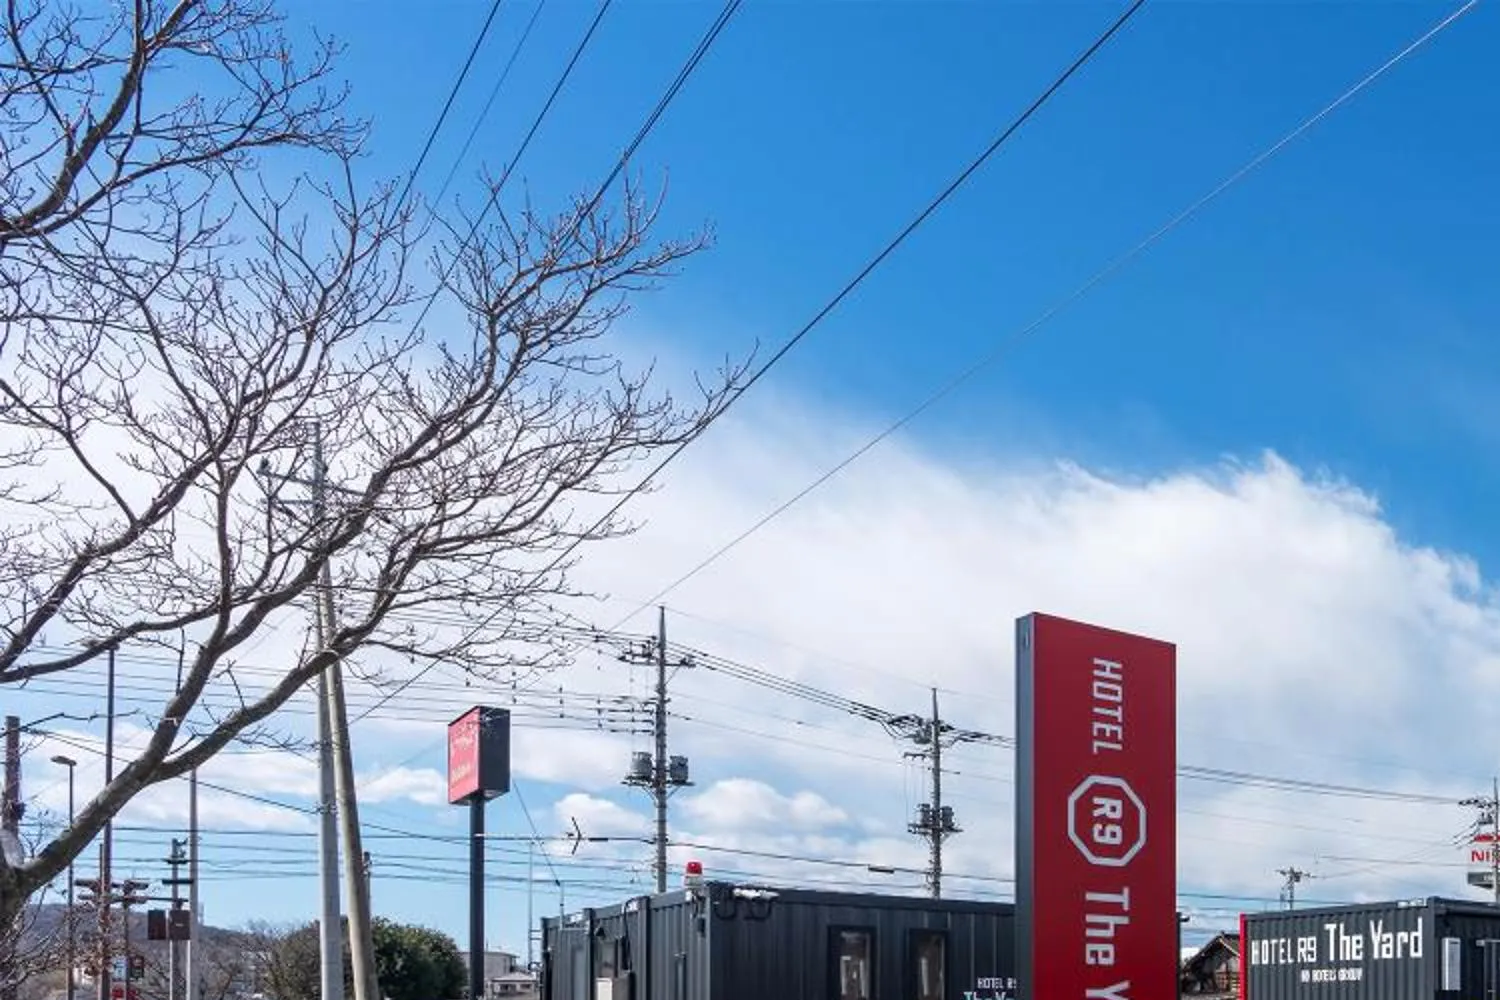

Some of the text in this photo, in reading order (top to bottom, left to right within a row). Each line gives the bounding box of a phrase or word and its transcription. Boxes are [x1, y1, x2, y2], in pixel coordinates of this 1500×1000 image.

[1092, 657, 1122, 755] HOTEL
[1092, 796, 1122, 845] R9
[1085, 887, 1129, 966] The
[1251, 916, 1423, 965] HOTEL R9 The Yard
[977, 977, 1003, 988] HOTEL
